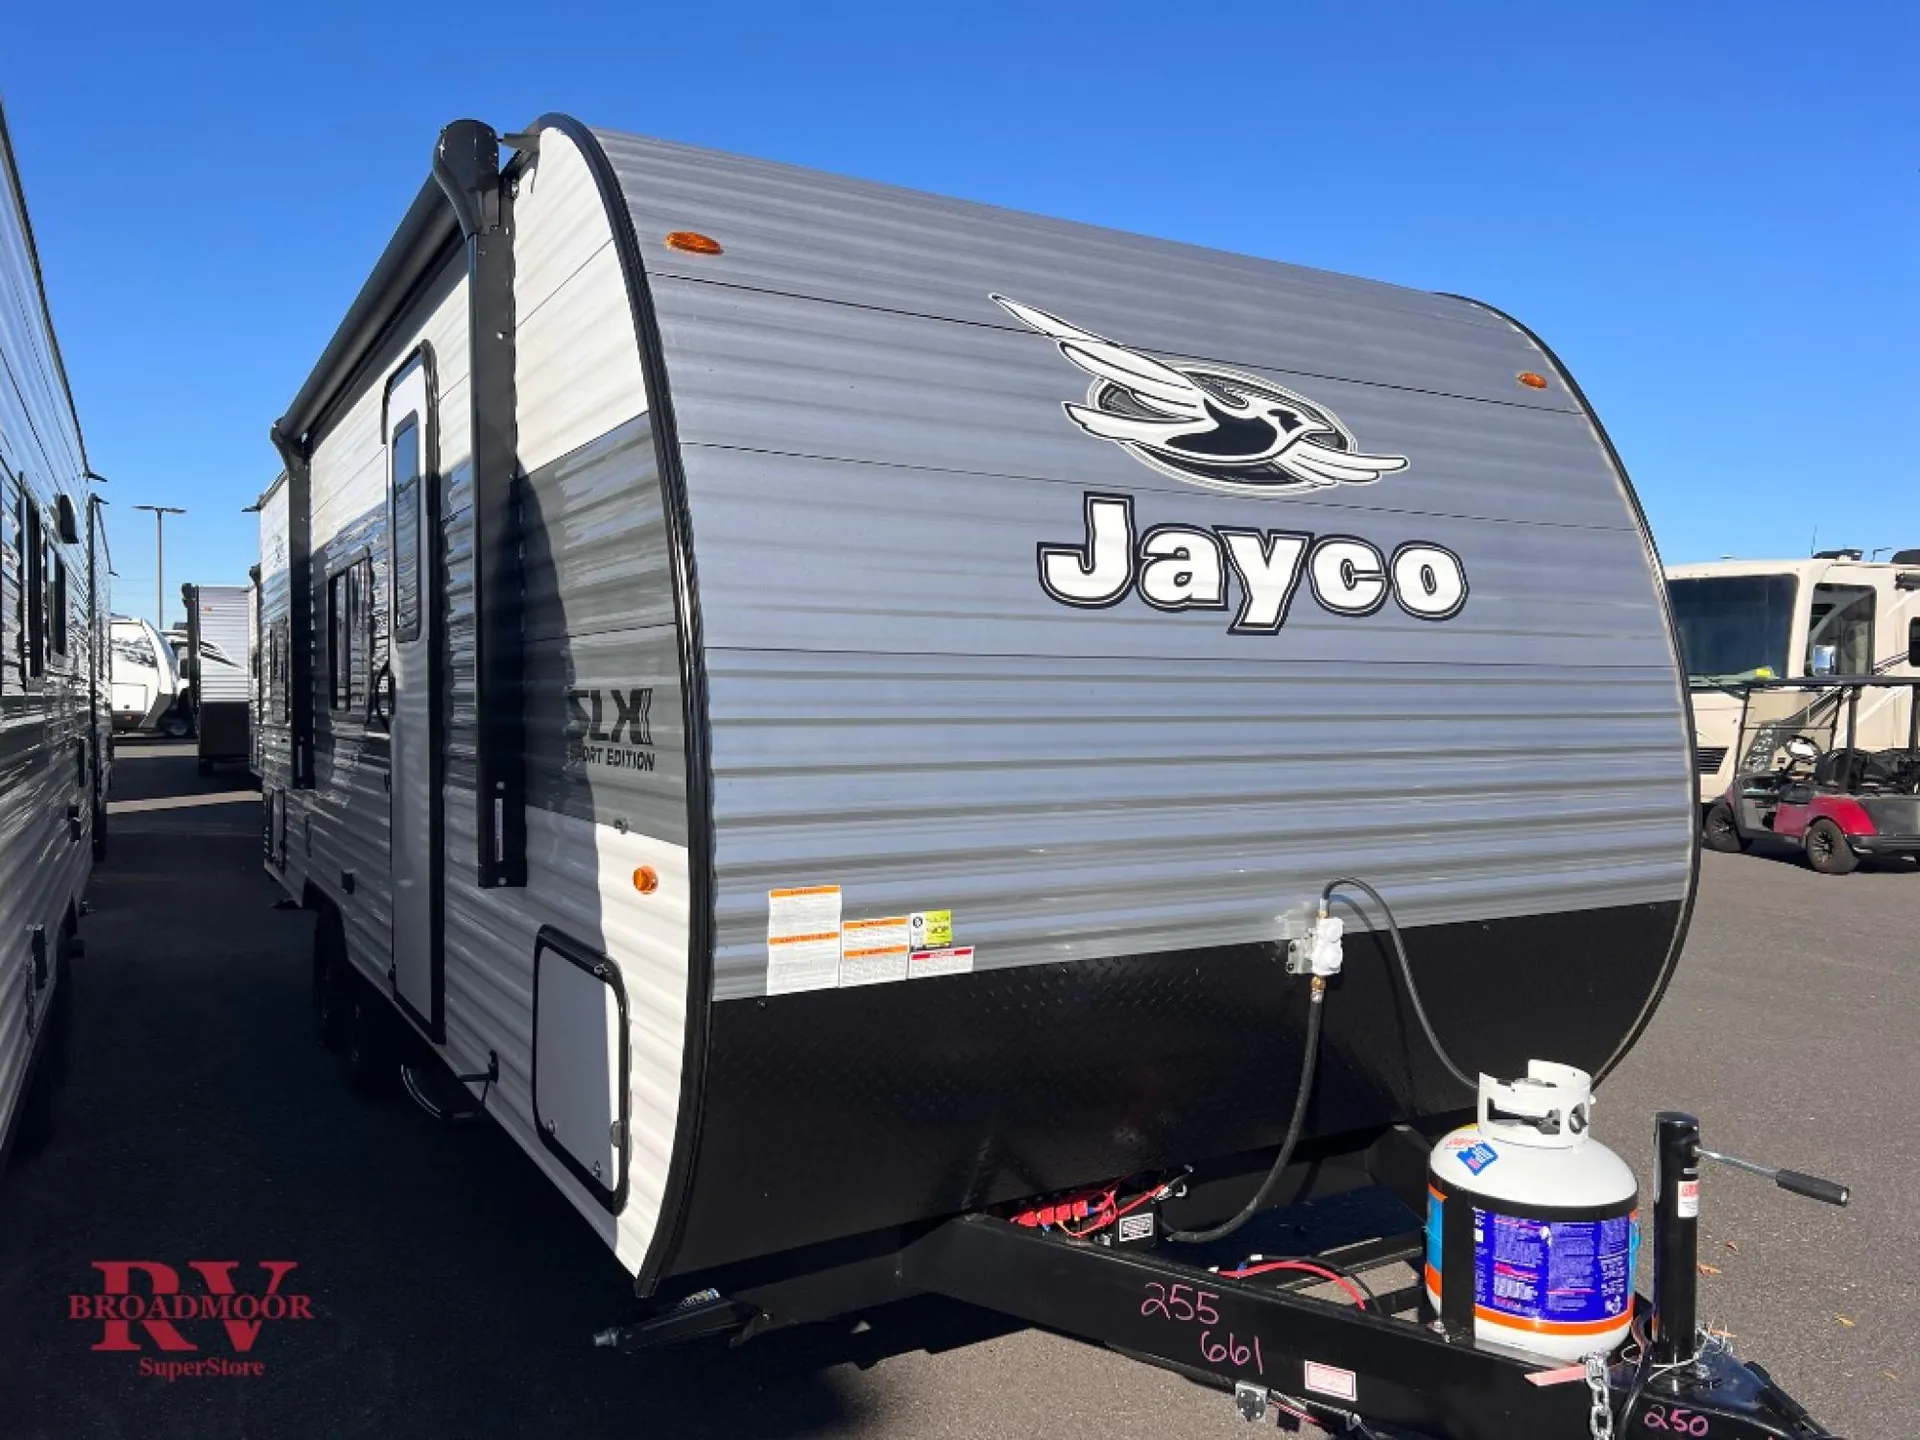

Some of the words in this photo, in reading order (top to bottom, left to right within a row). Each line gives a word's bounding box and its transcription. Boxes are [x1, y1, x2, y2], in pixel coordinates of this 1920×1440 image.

[1037, 491, 1469, 635] Jayco
[566, 688, 653, 746] SLX
[606, 747, 655, 772] EDITION
[1141, 1282, 1219, 1324] 255
[1201, 1331, 1263, 1375] 661
[1644, 1404, 1708, 1436] 250
